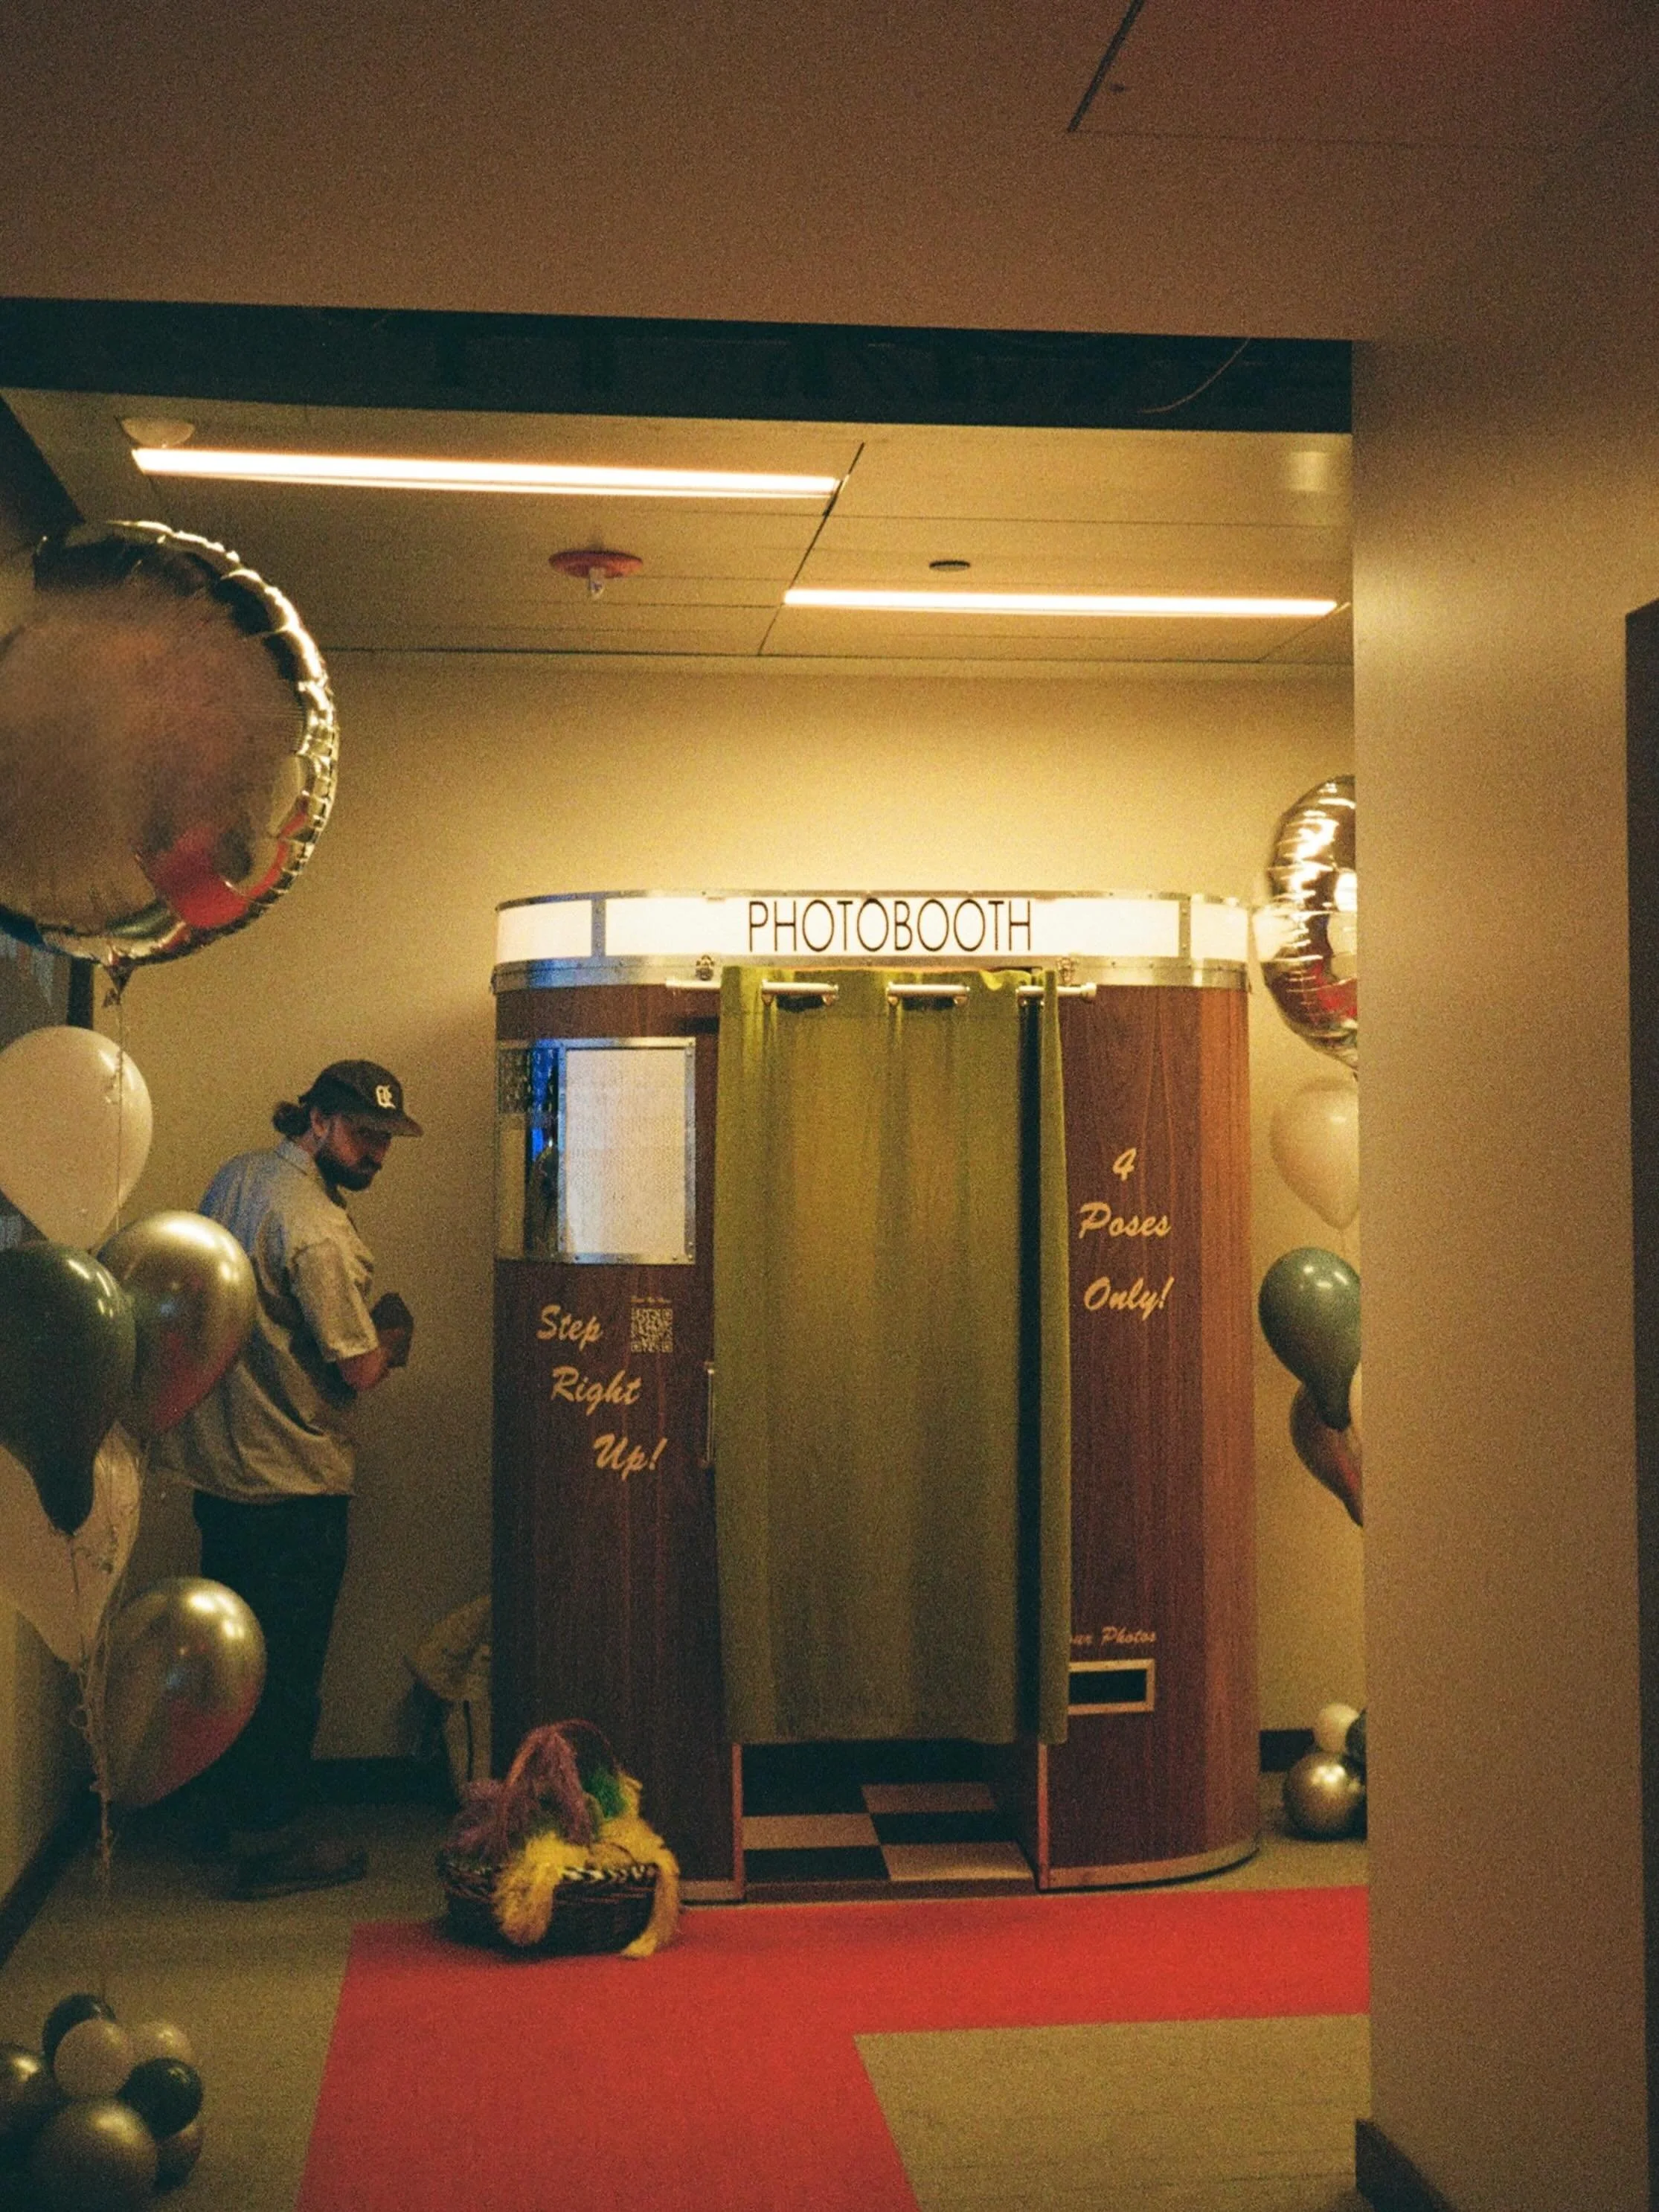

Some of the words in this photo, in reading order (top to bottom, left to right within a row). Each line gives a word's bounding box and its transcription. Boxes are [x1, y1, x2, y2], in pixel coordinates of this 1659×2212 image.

[749, 898, 1031, 953] PHOTOBOOTH
[1113, 1147, 1137, 1182] 4
[1079, 1202, 1172, 1239] Poses
[1083, 1276, 1175, 1321] Only!
[536, 1304, 604, 1352] Step
[550, 1365, 641, 1416] Right
[593, 1433, 668, 1481] Up!
[1101, 1626, 1156, 1646] Photos
